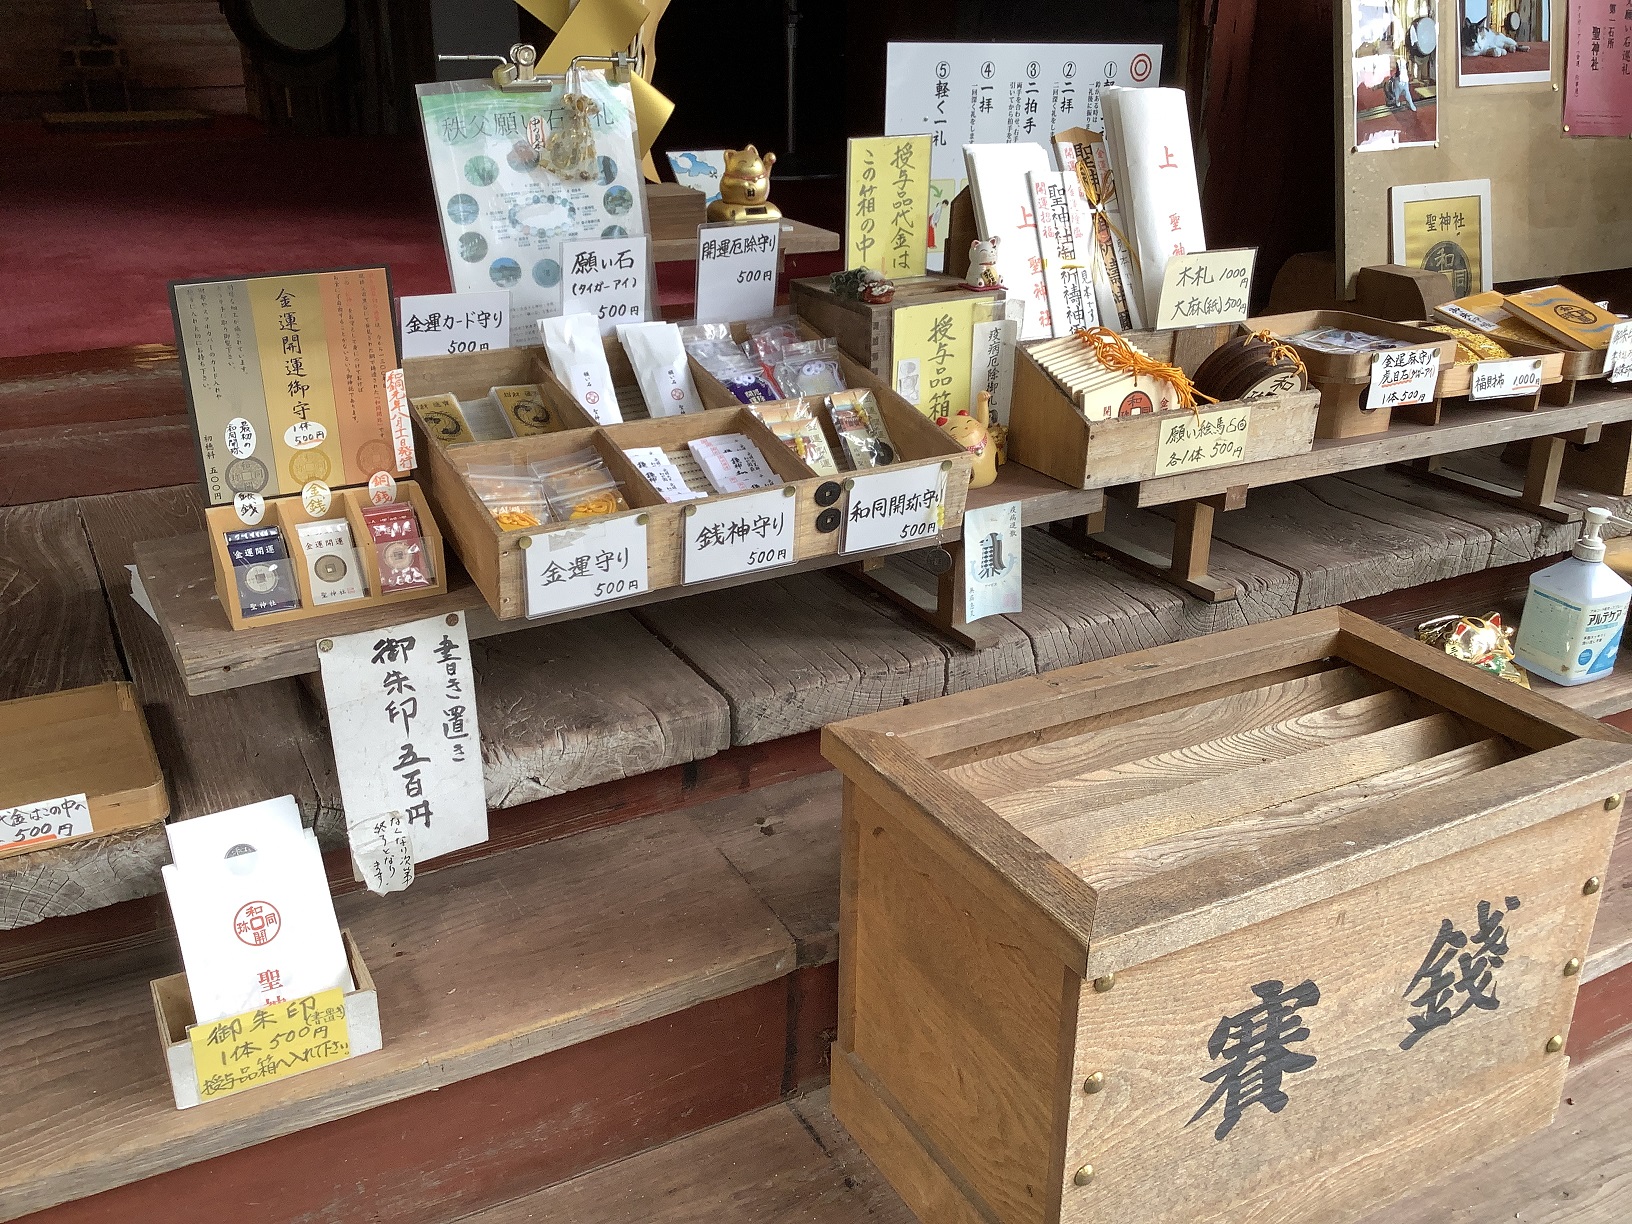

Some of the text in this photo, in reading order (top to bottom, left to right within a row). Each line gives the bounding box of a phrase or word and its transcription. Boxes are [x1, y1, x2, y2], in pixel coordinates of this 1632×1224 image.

[1158, 145, 1179, 170] 上
[889, 141, 915, 269] 授与品代金は
[1015, 205, 1038, 230] 上
[1425, 211, 1466, 232] 聖神社
[700, 233, 777, 262] 開運厄除守り
[570, 249, 636, 276] 願い石
[571, 275, 638, 297] (タイガーアイ)
[735, 268, 773, 284] 500円
[1175, 265, 1249, 289] 木札 1000円
[1027, 255, 1053, 328] 聖神社
[597, 303, 640, 320] 500円
[1223, 298, 1247, 315] 500円
[405, 309, 504, 336] 金運カード守り
[274, 287, 312, 421] 金運開運御守
[447, 339, 490, 355] 500円
[926, 313, 957, 422] 授与品箱
[1474, 372, 1505, 393] 福財布
[1399, 389, 1426, 402] 500円
[239, 420, 253, 449] 最初の
[294, 430, 325, 446] 500円
[1165, 417, 1226, 446] 願い絵馬
[1209, 440, 1244, 460] 500円
[305, 482, 328, 515] 金銭
[372, 474, 393, 504] 銅銭
[695, 511, 785, 551] 銭神守り
[899, 521, 937, 539] 500円
[232, 543, 275, 560] 金運開運
[305, 537, 345, 551] 金運開運
[540, 546, 630, 588] 金運守り
[746, 548, 787, 566] 500円
[593, 579, 639, 598] 500円
[1586, 609, 1623, 627] アルテケア
[432, 634, 469, 763] 書き置き
[370, 635, 433, 829] 御朱印五百円
[12, 822, 74, 843] 500円
[389, 816, 413, 886] なくなり次第
[206, 995, 316, 1047] 御朱印
[221, 1025, 329, 1066] 1体 500円
